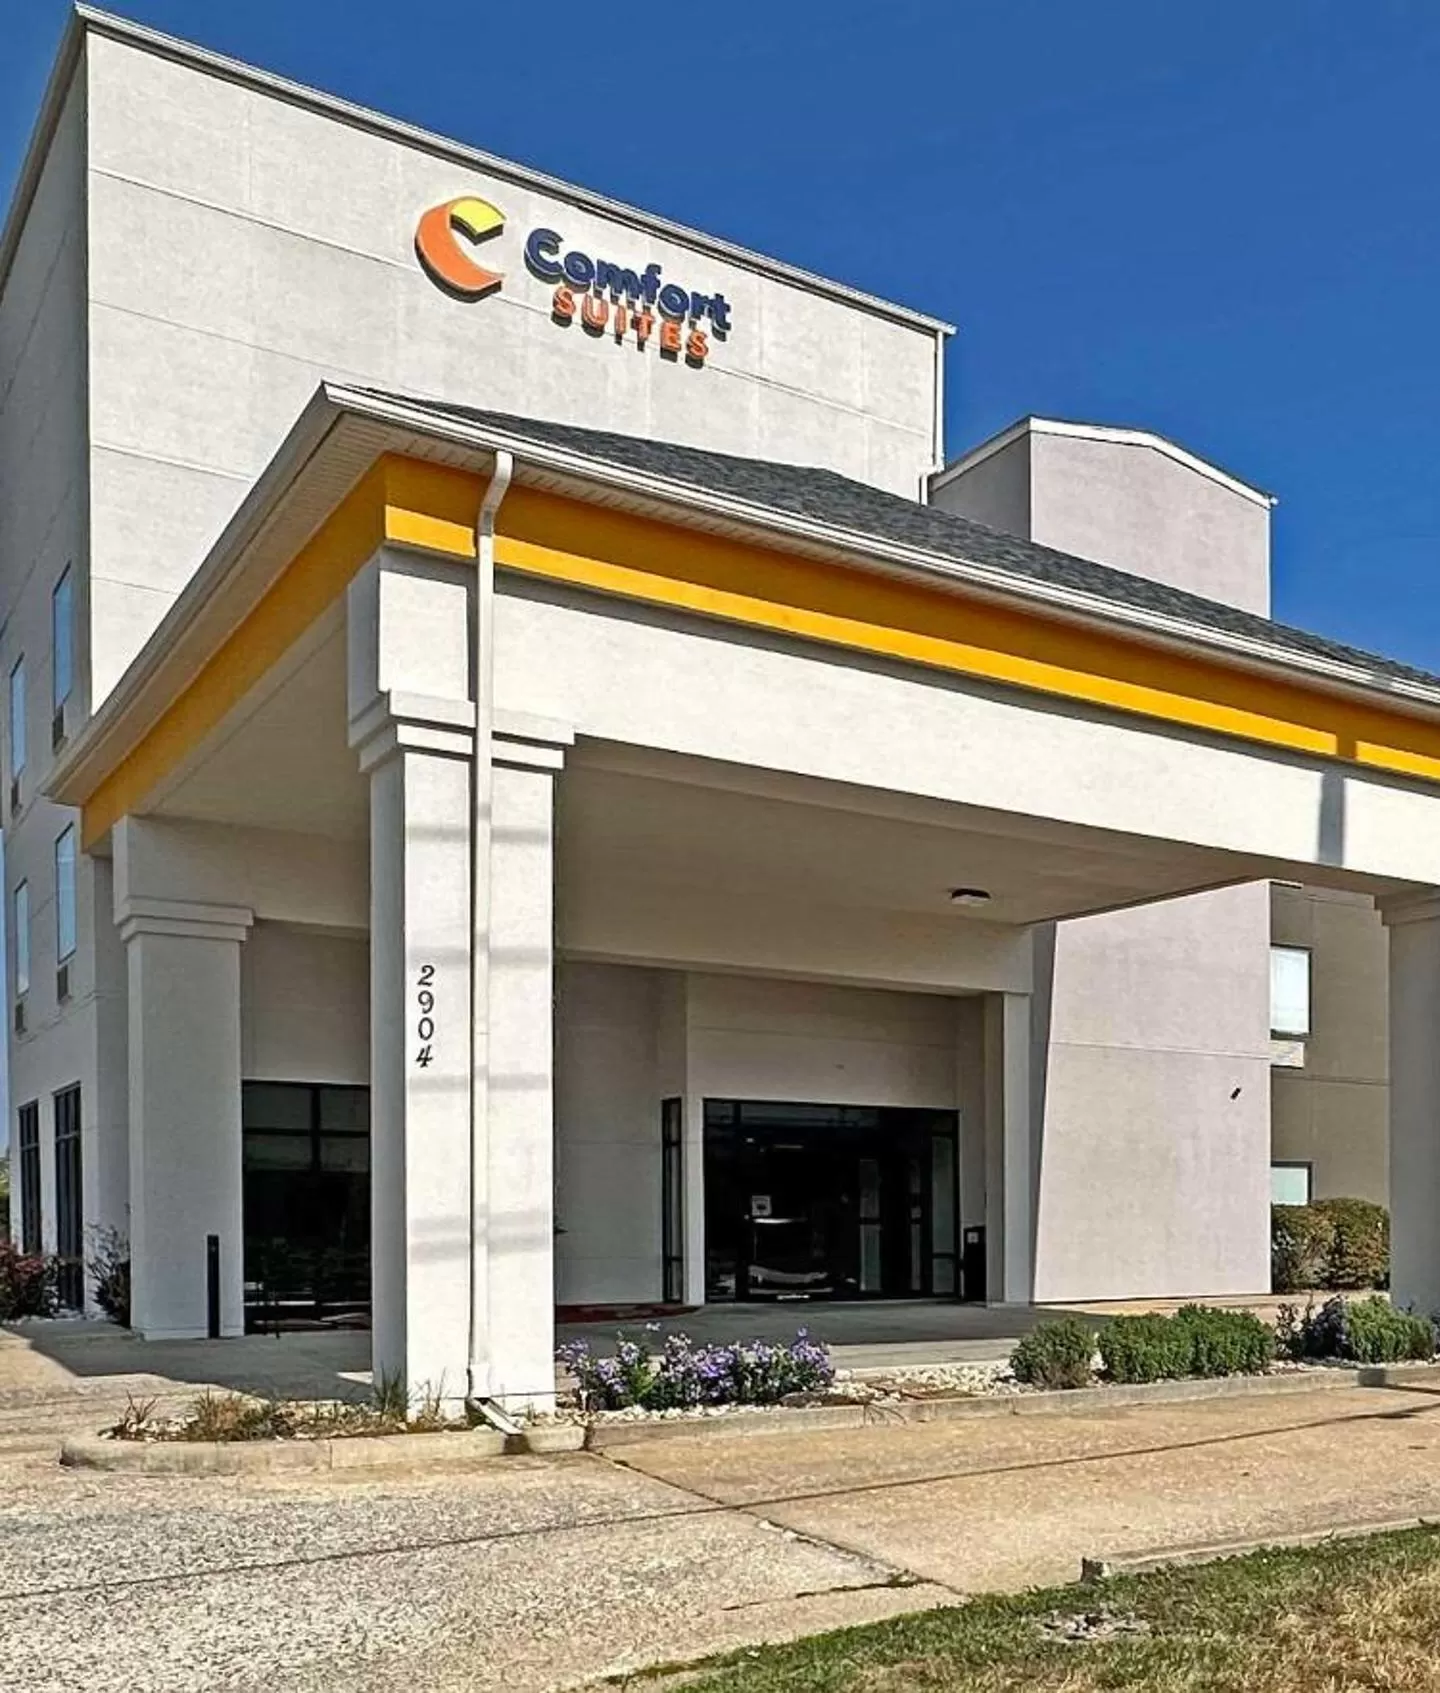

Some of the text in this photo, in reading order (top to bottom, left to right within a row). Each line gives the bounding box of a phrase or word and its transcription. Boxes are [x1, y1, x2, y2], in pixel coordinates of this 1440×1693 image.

[525, 228, 731, 337] Comfort
[552, 286, 709, 365] SUITES
[416, 965, 435, 1068] 2904
